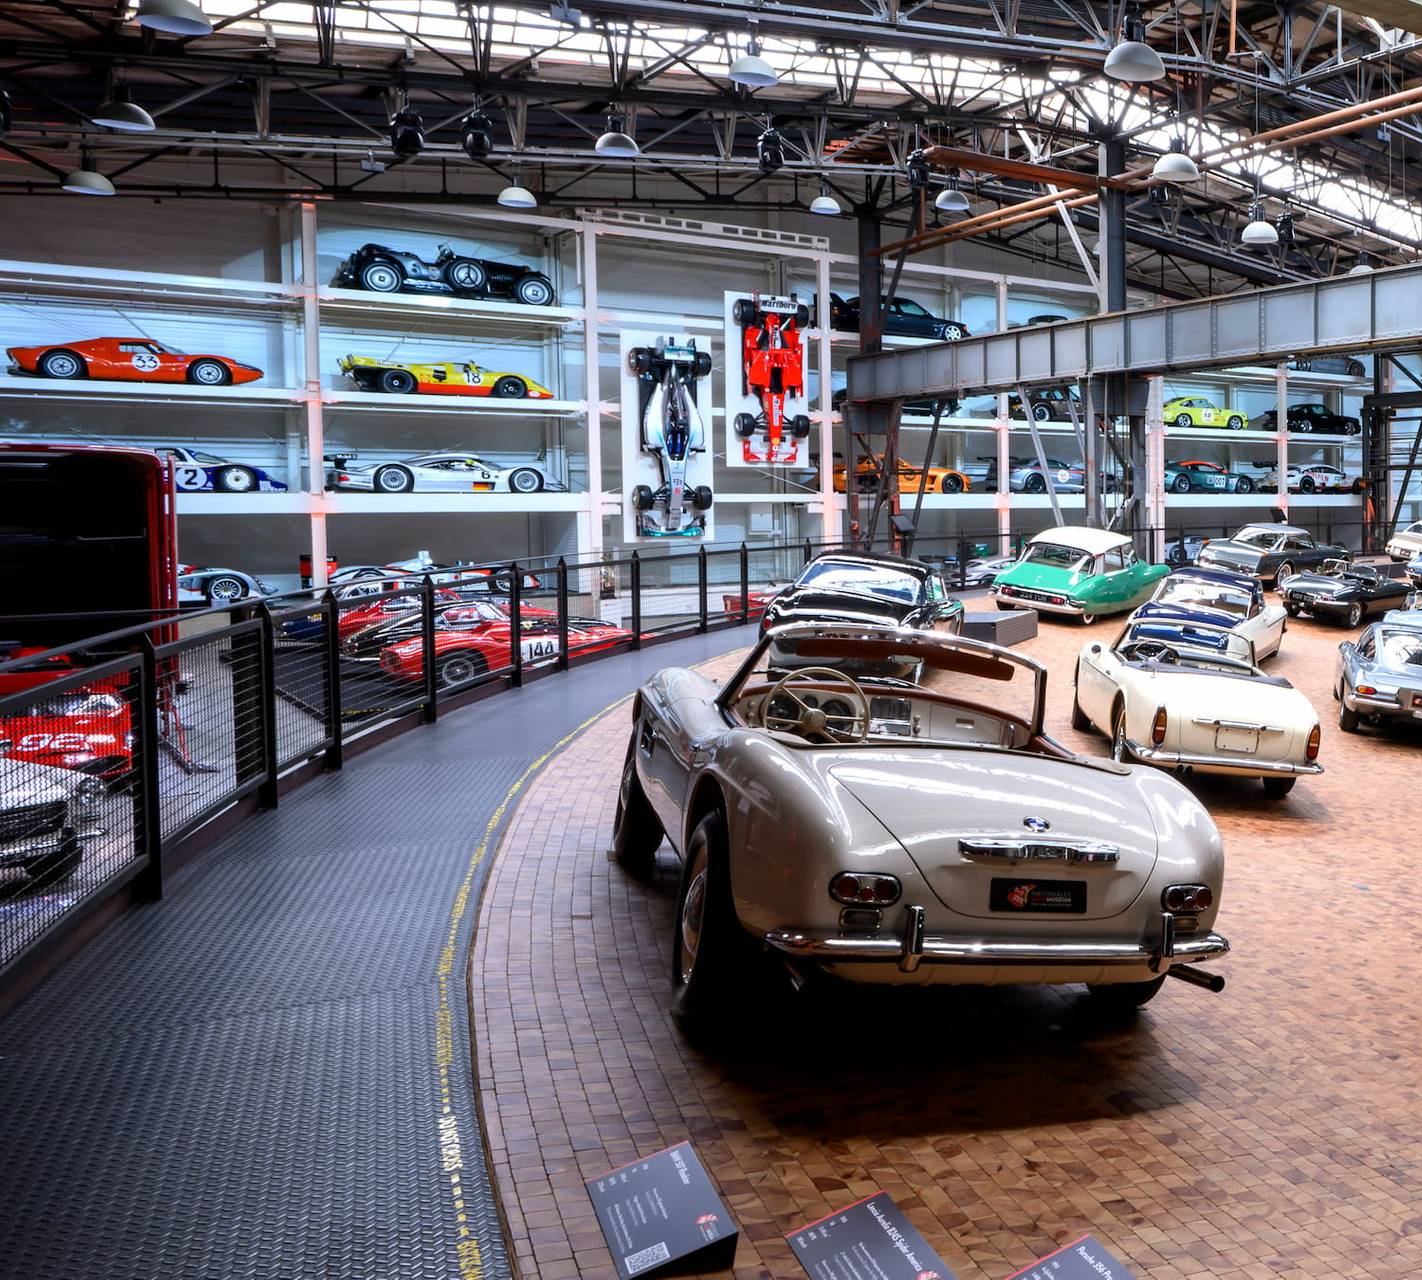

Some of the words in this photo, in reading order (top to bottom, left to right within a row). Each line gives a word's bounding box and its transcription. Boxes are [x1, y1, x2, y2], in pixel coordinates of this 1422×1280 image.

[135, 355, 158, 369] 33
[466, 371, 481, 384] 18
[184, 469, 198, 486] 2
[481, 471, 491, 480] 6
[529, 641, 554, 660] 144
[438, 1116, 457, 1129] DO
[440, 1128, 459, 1145] NOT
[441, 1144, 463, 1171] CROSS
